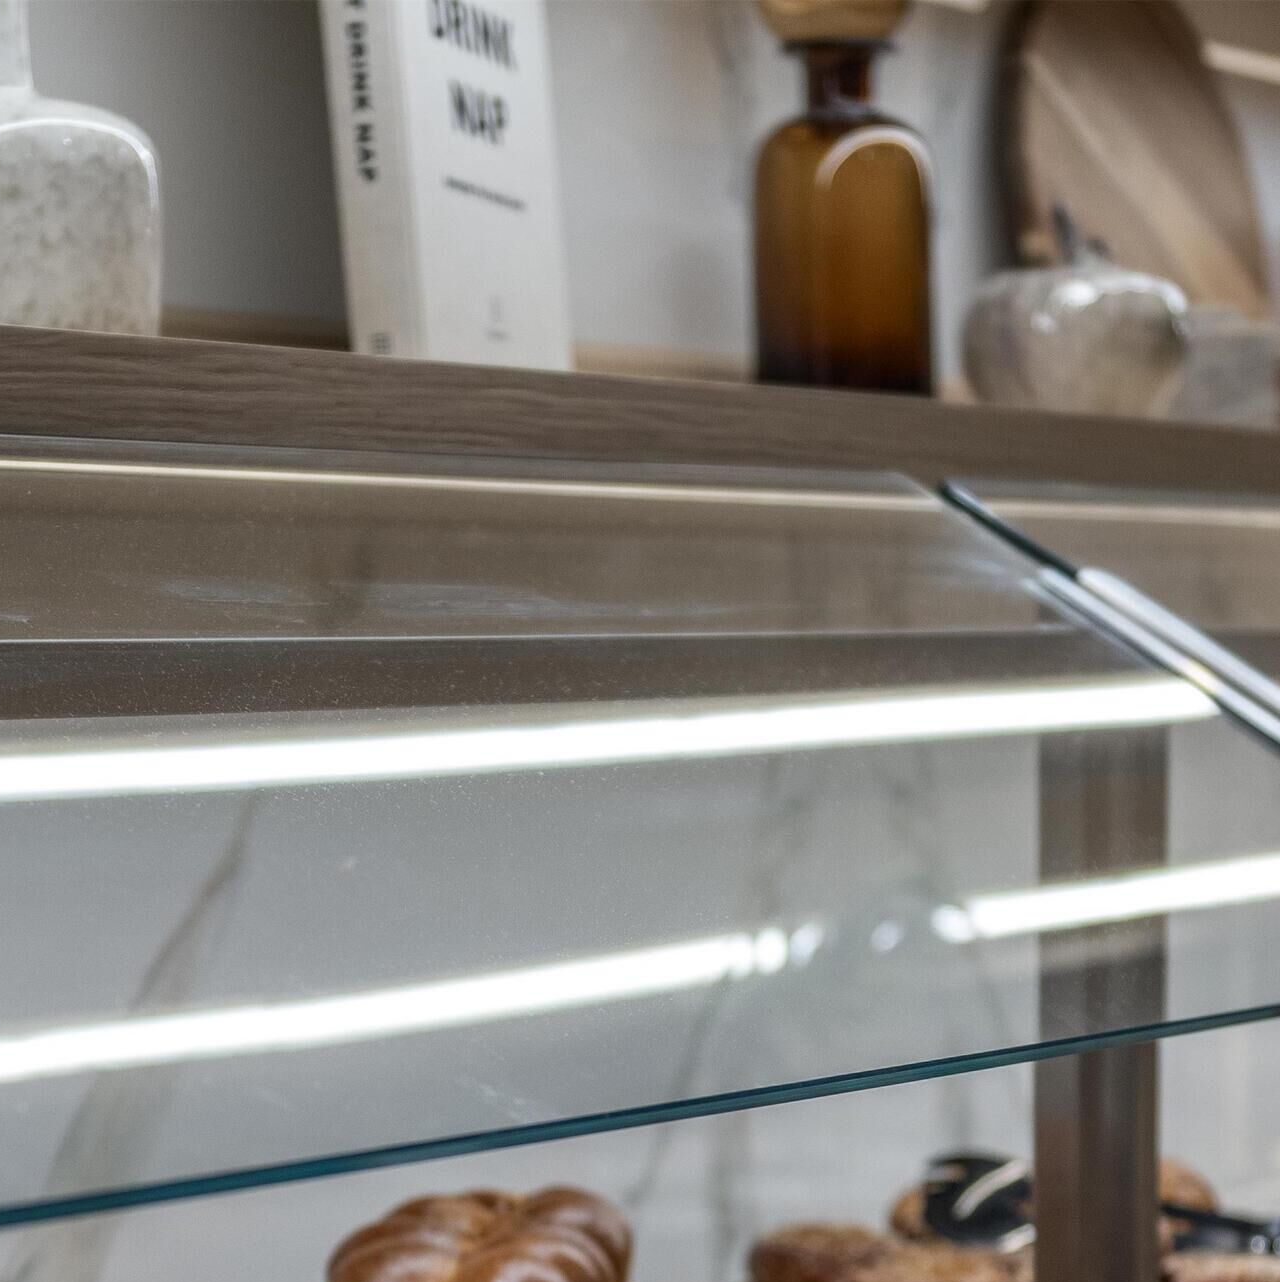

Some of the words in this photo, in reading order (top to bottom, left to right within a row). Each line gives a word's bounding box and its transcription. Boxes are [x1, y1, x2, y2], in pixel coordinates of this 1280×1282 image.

[346, 21, 372, 111] DRINK
[448, 78, 508, 144] NAP
[355, 123, 378, 182] NAP
